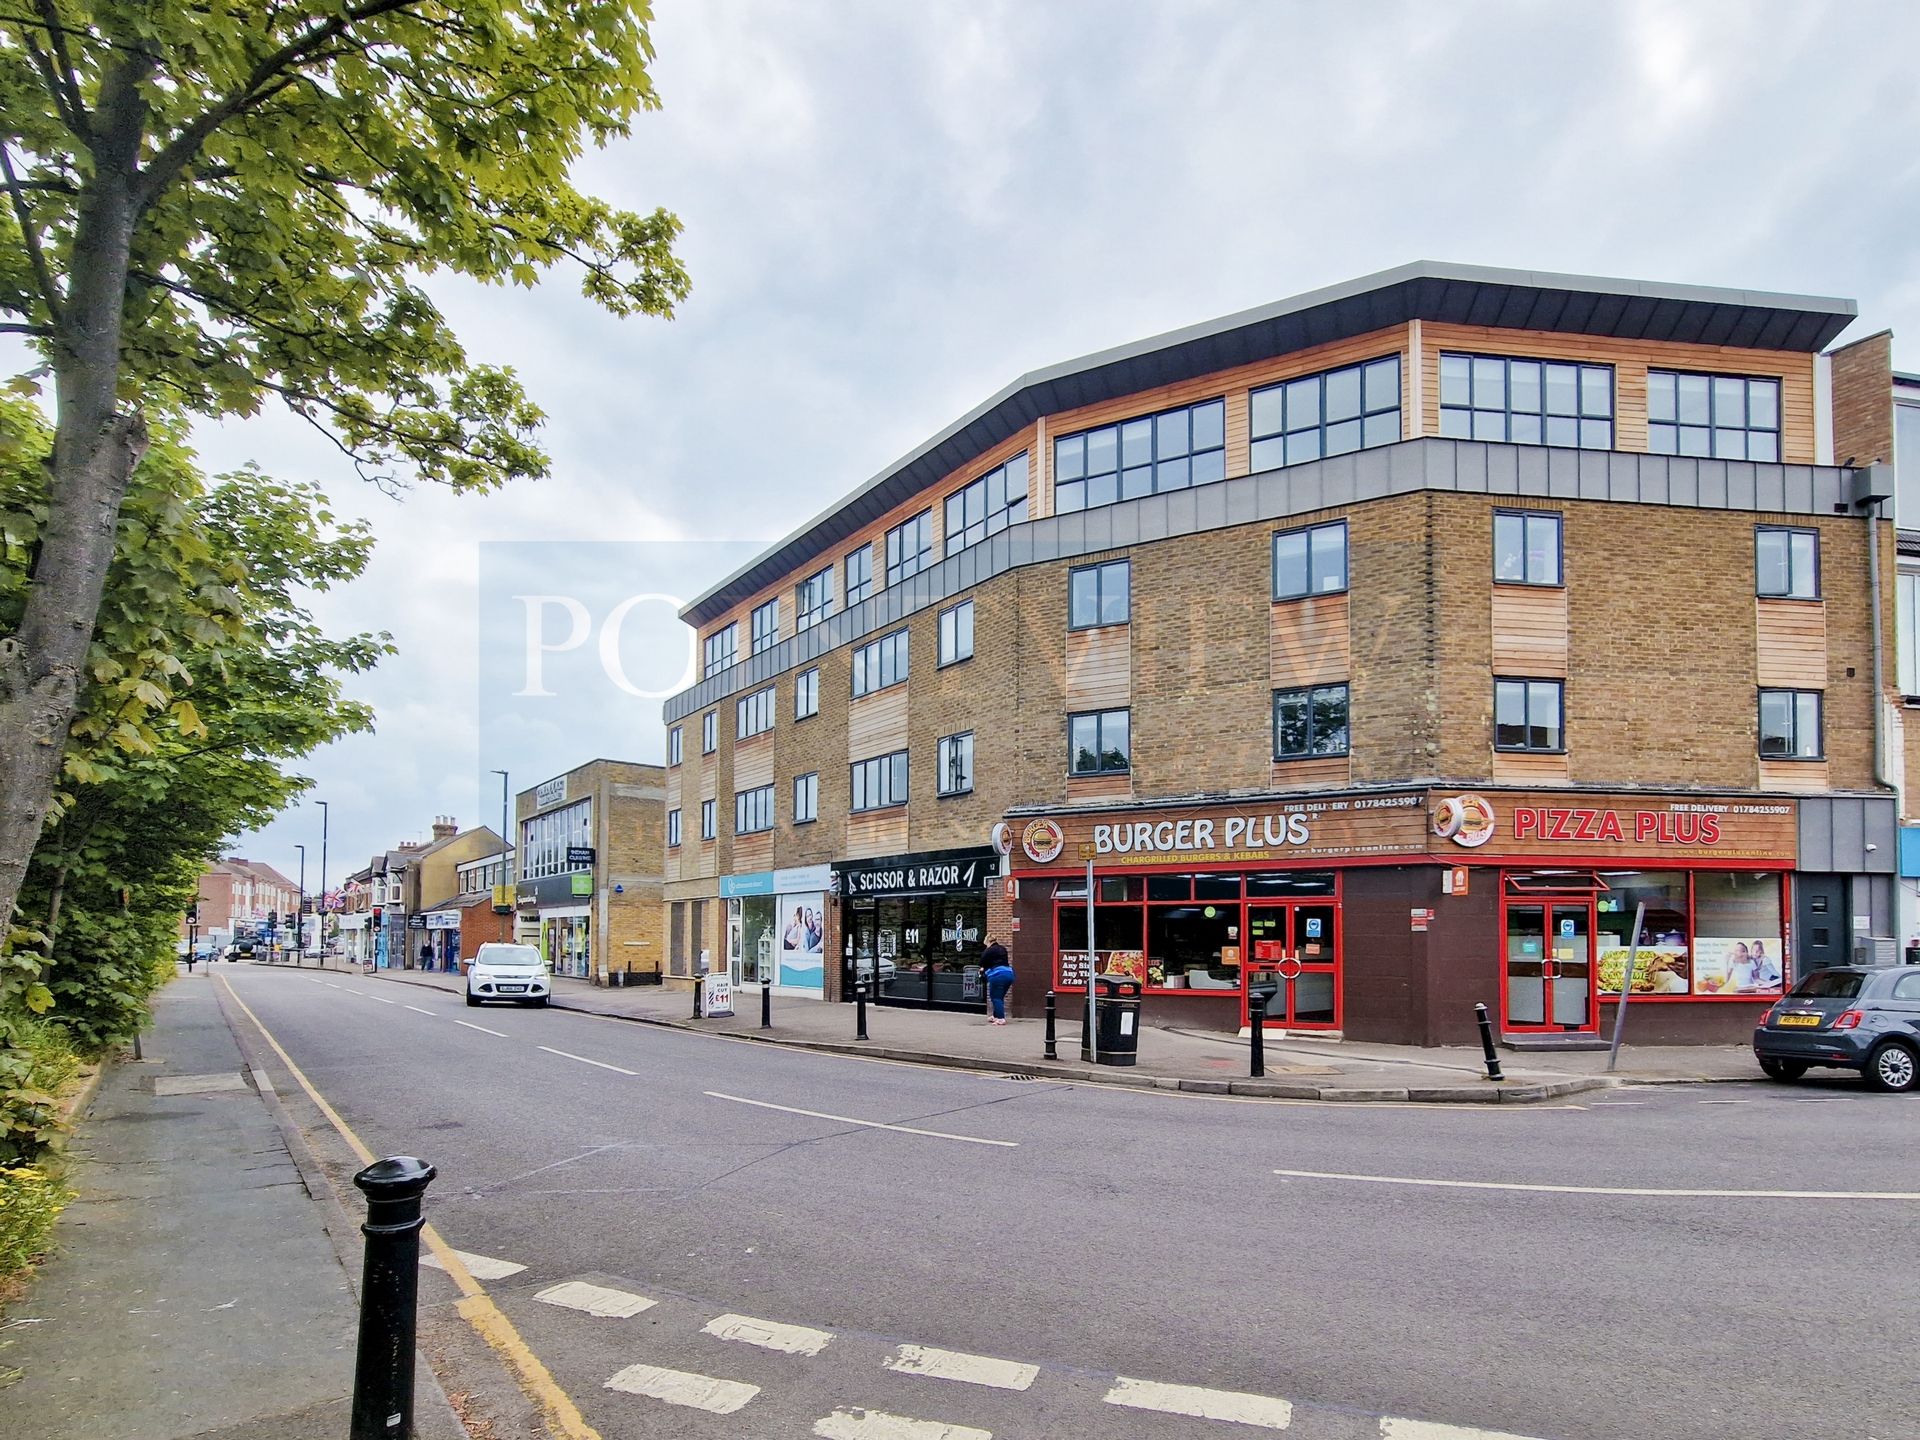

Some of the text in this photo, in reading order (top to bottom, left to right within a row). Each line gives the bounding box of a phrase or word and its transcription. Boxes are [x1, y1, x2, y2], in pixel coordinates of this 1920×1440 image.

[1284, 805, 1305, 813] FREE
[1307, 801, 1349, 812] DELIERY
[1670, 804, 1689, 812] FREE
[1691, 804, 1728, 813] DELIVERY
[1514, 807, 1721, 845] PIZZA PLUS
[1093, 820, 1214, 854] BURGER
[1225, 813, 1311, 849] PLUS
[1120, 851, 1270, 864] CHARGRILLED BURGERS & KEBABS
[860, 866, 959, 890] SCISSOR & RAZOR
[906, 928, 919, 944] £11
[963, 928, 978, 942] SHOP
[1062, 954, 1078, 962] Any
[1062, 962, 1078, 970] Any
[1062, 970, 1078, 978] Any
[716, 994, 728, 1002] £11
